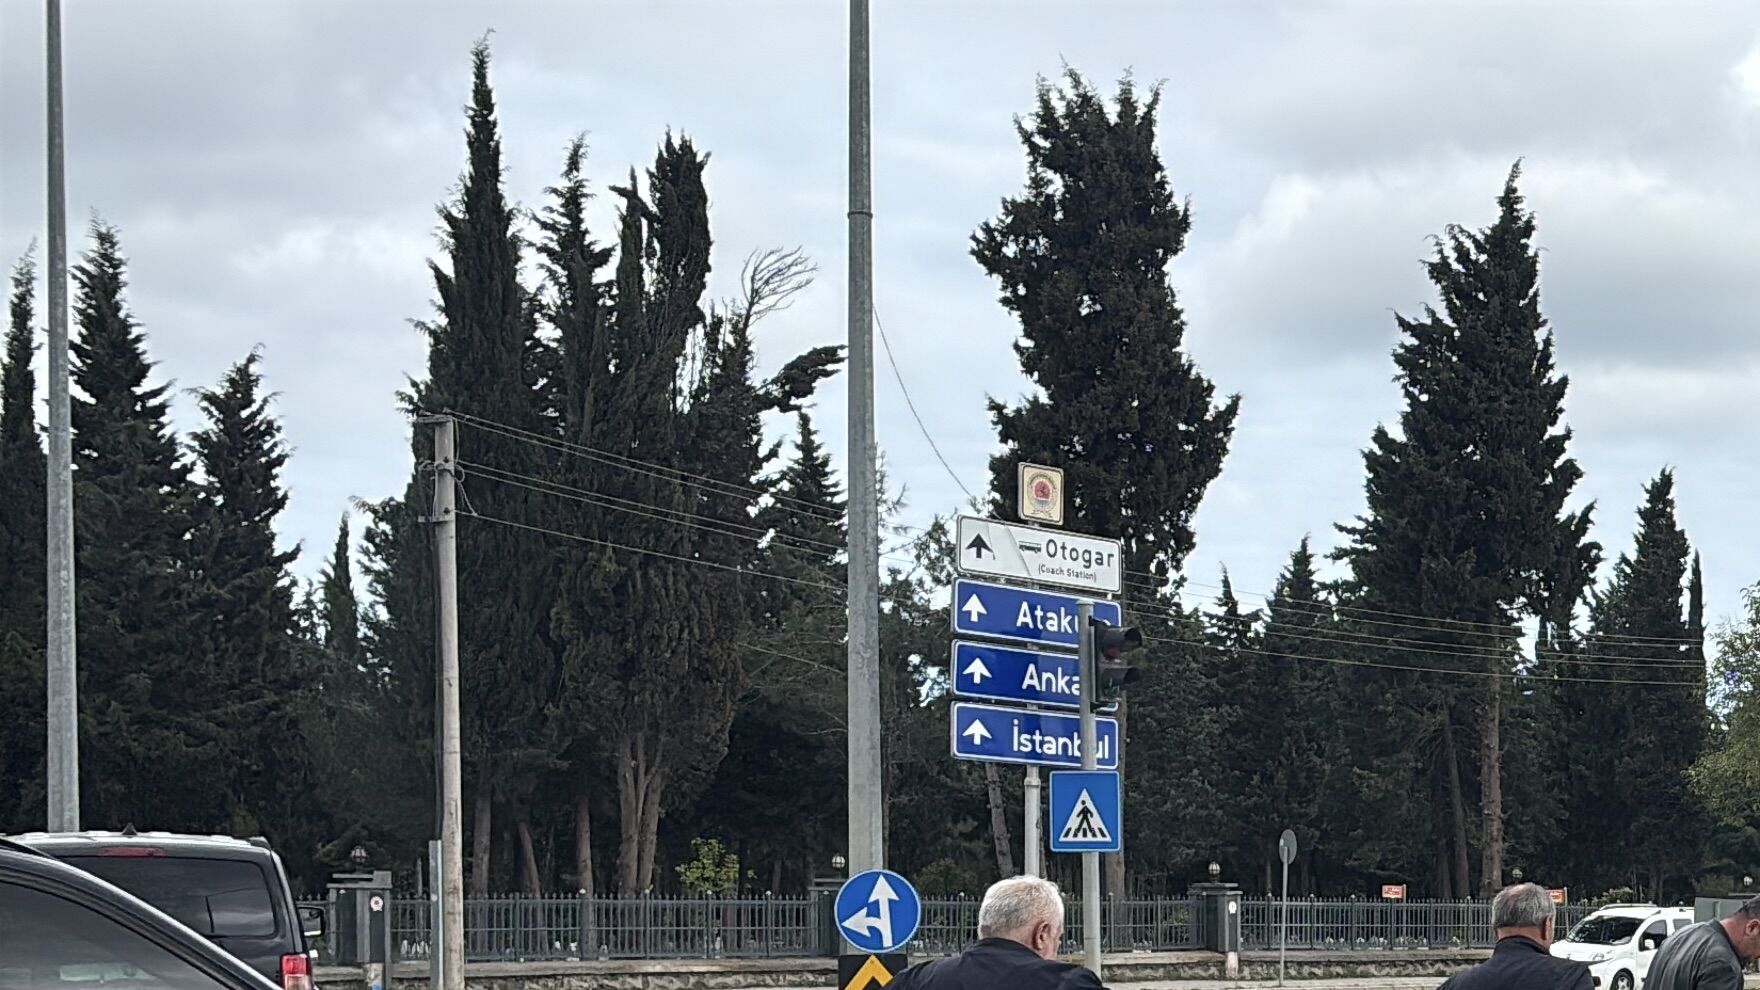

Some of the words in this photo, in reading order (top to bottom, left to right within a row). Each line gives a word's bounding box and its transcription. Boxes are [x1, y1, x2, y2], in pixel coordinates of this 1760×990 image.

[1046, 538, 1115, 569] Otogar
[1066, 568, 1097, 583] Station)
[1016, 601, 1080, 634] Atak
[1022, 663, 1081, 696] Anka
